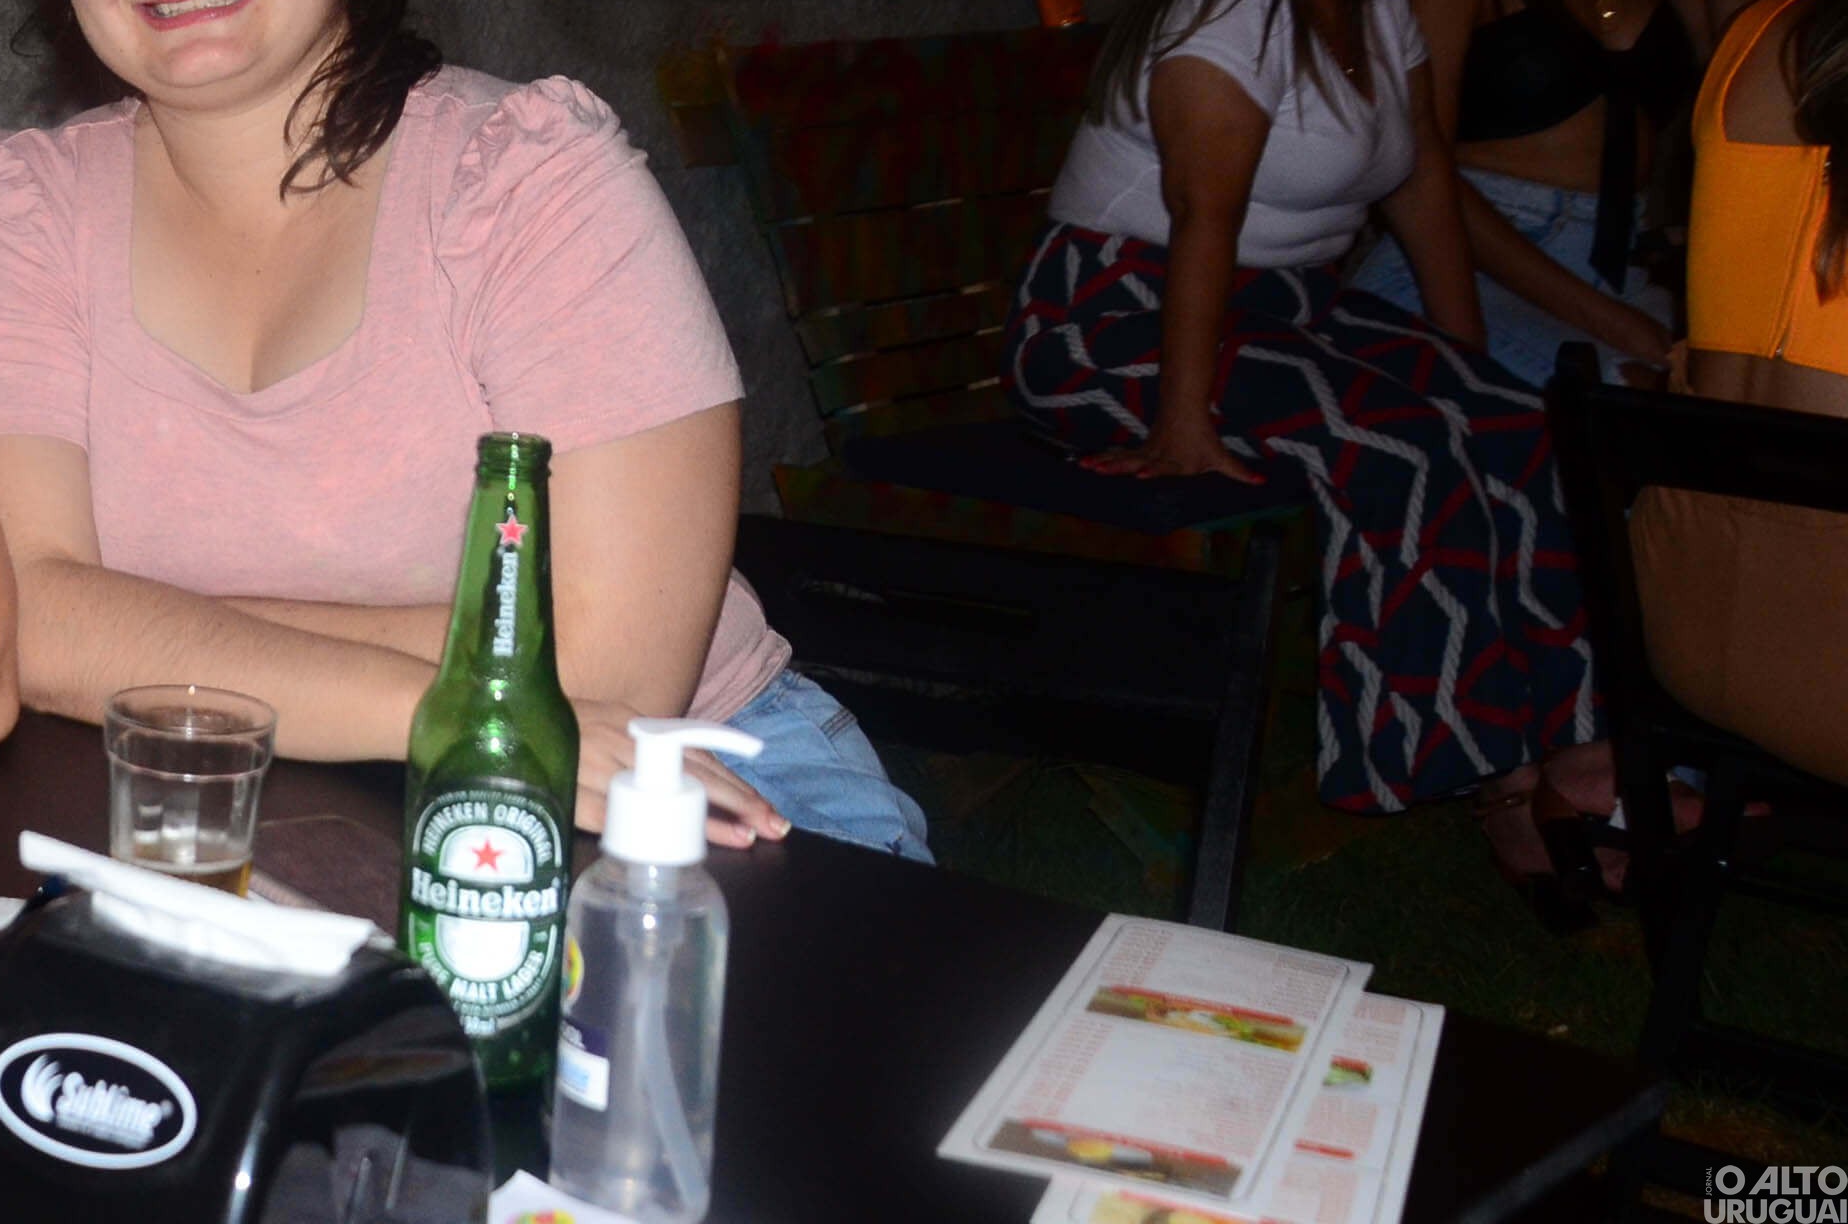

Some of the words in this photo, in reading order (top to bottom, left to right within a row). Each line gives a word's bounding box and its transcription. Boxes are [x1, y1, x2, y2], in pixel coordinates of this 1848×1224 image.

[492, 551, 519, 656] Heineken
[421, 801, 489, 857] HEINEKEN
[493, 803, 553, 867] ORIGINAL
[411, 866, 558, 918] Heineken
[449, 976, 498, 1005] MALT
[502, 949, 545, 1001] LAGER
